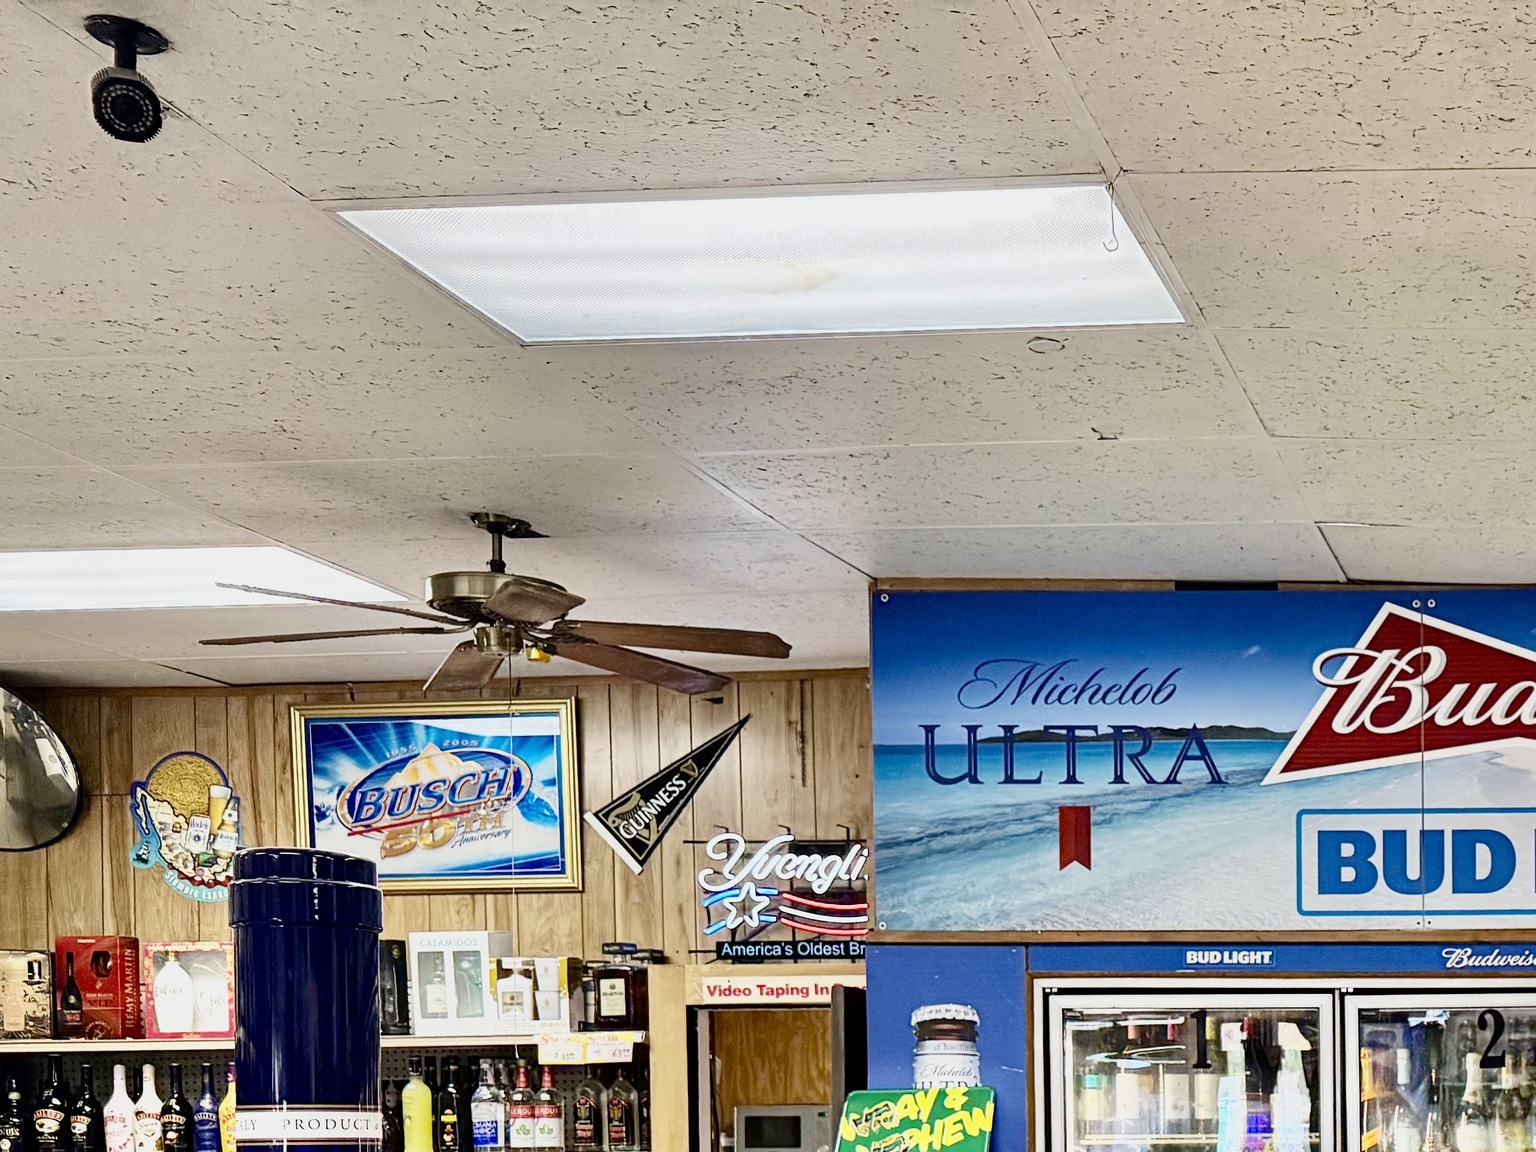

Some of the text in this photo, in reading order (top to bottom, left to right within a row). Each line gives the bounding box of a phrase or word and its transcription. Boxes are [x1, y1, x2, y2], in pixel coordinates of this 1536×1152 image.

[958, 658, 1184, 710] Michelob
[919, 724, 1229, 785] ULTRA
[352, 766, 517, 826] BUSCH
[619, 774, 687, 840] GUINNESS
[698, 833, 869, 894] Yuengli
[1317, 828, 1516, 896] BUD
[420, 938, 478, 947] CASAMIGOS
[722, 942, 866, 956] America's Oldest Br
[1186, 951, 1273, 964] BUD LIGHT
[707, 984, 752, 997] Video
[757, 984, 810, 1000] Taping
[815, 983, 830, 995] In
[1191, 1009, 1213, 1069] 1
[1478, 1009, 1506, 1068] 2
[283, 1118, 371, 1130] PRODUCT
